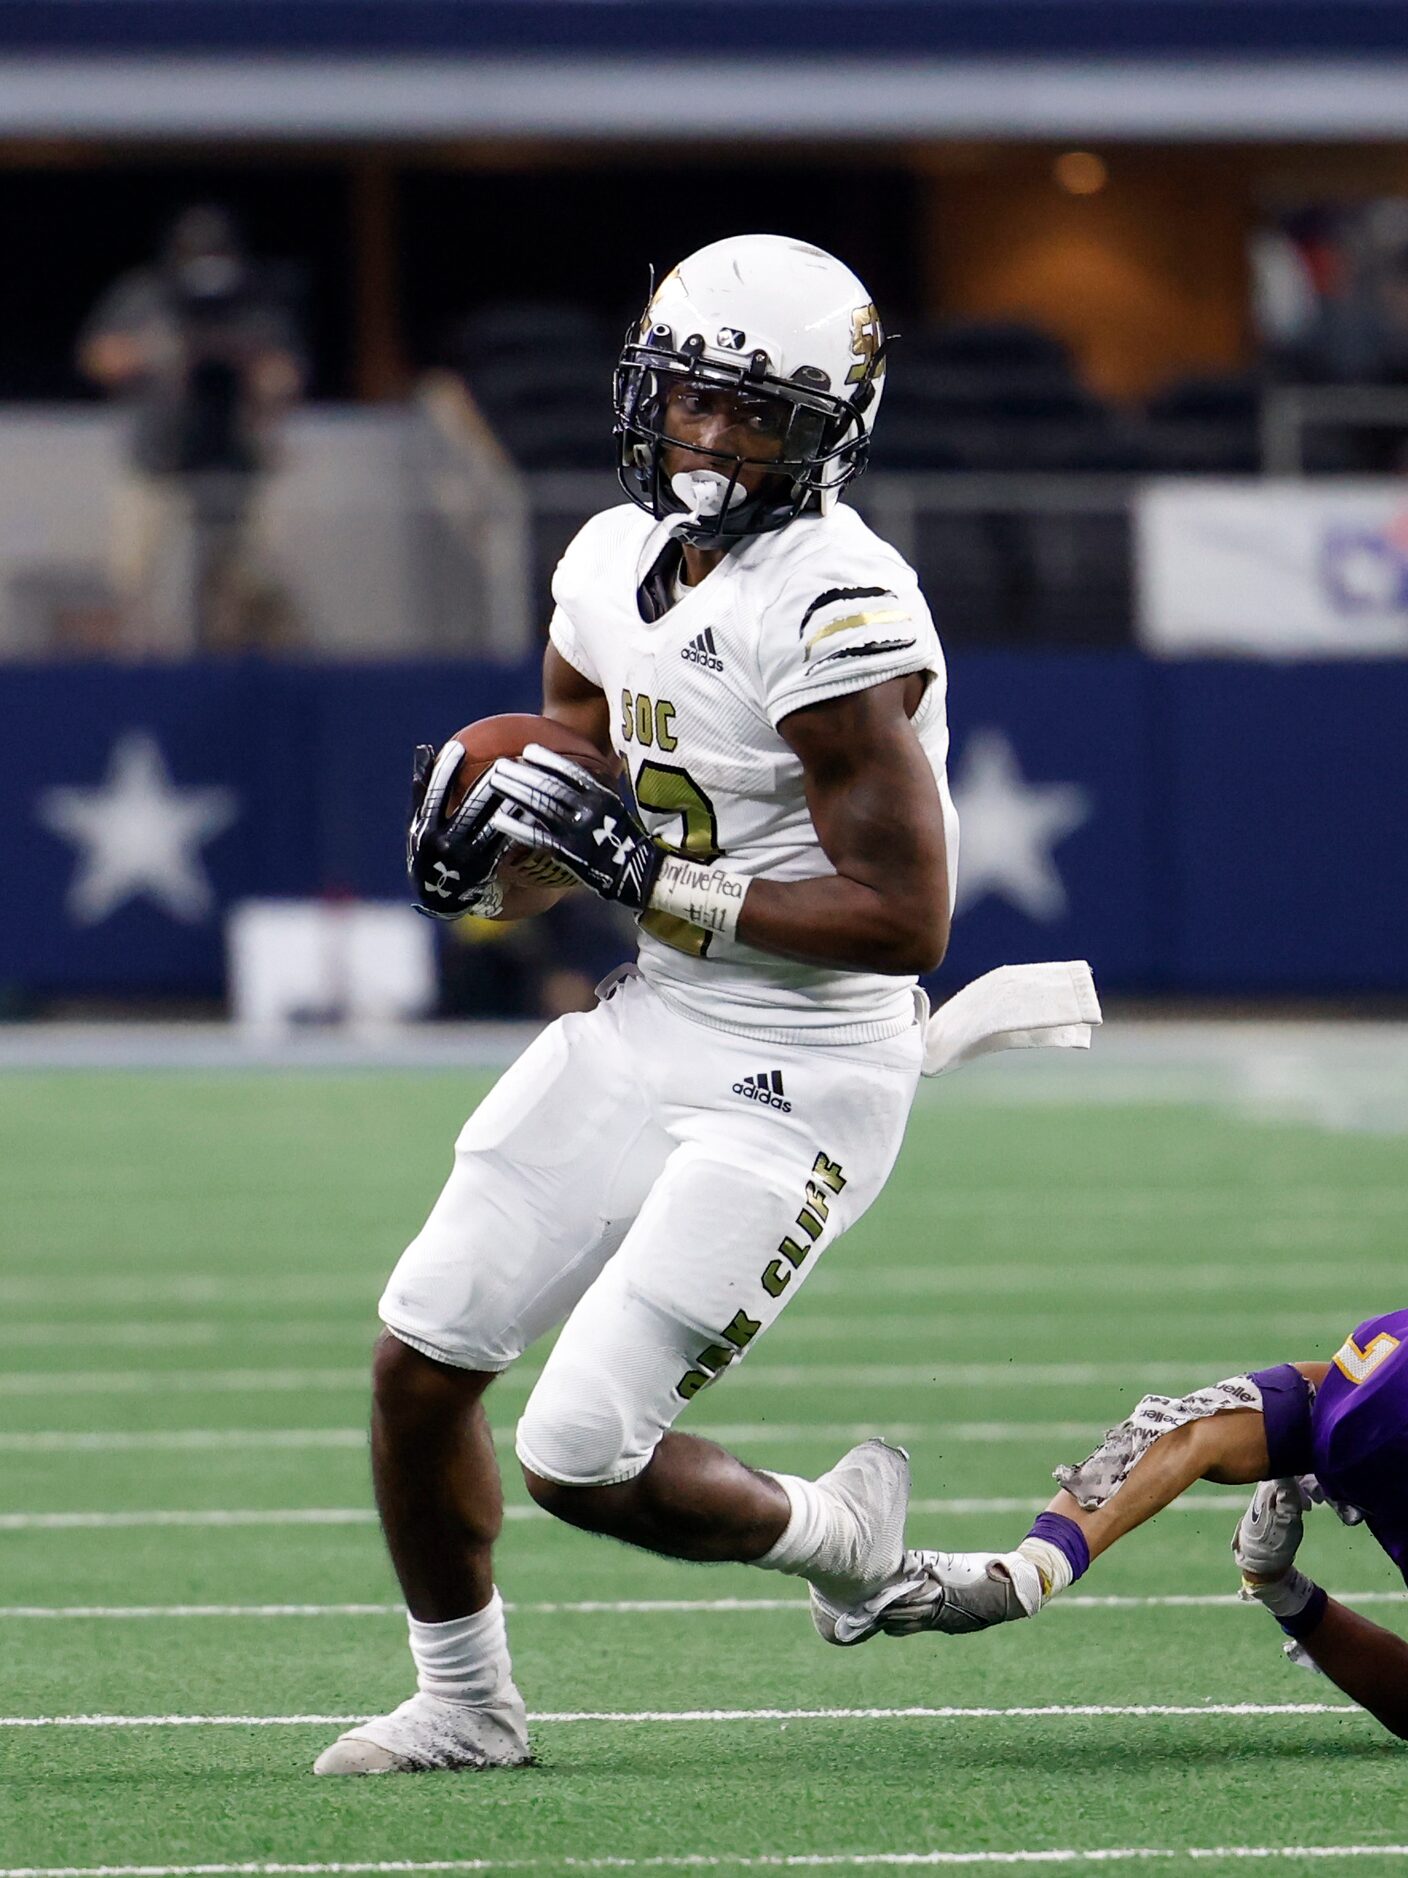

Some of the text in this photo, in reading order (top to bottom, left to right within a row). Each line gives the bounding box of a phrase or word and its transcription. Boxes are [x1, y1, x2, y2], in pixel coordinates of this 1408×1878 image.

[680, 648, 724, 673] adidas
[621, 688, 678, 753] SOC
[732, 1083, 792, 1113] adidas
[761, 1152, 848, 1299] CLIFF
